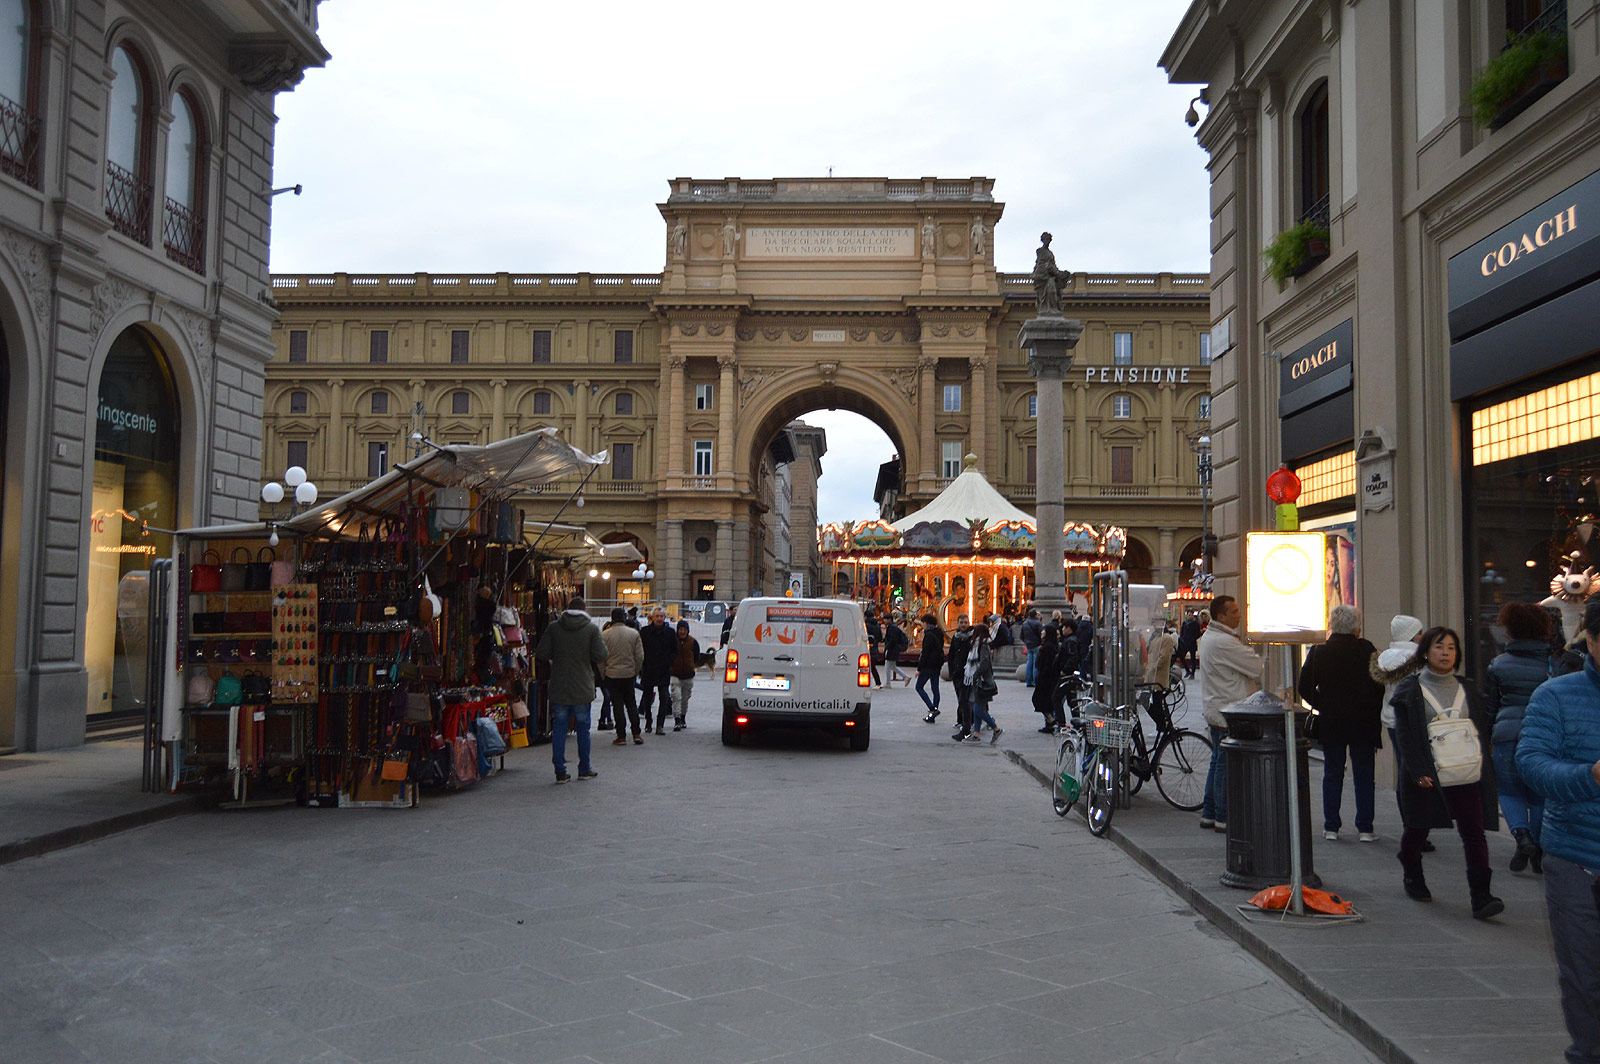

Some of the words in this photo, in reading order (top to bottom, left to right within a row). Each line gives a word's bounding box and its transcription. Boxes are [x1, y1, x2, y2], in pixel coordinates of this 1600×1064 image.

[1481, 204, 1577, 276] COACH
[1291, 340, 1337, 380] COACH
[1085, 367, 1190, 383] PENSIONE
[1365, 480, 1388, 492] COACH
[743, 697, 851, 710] soluzioniverticali.it
